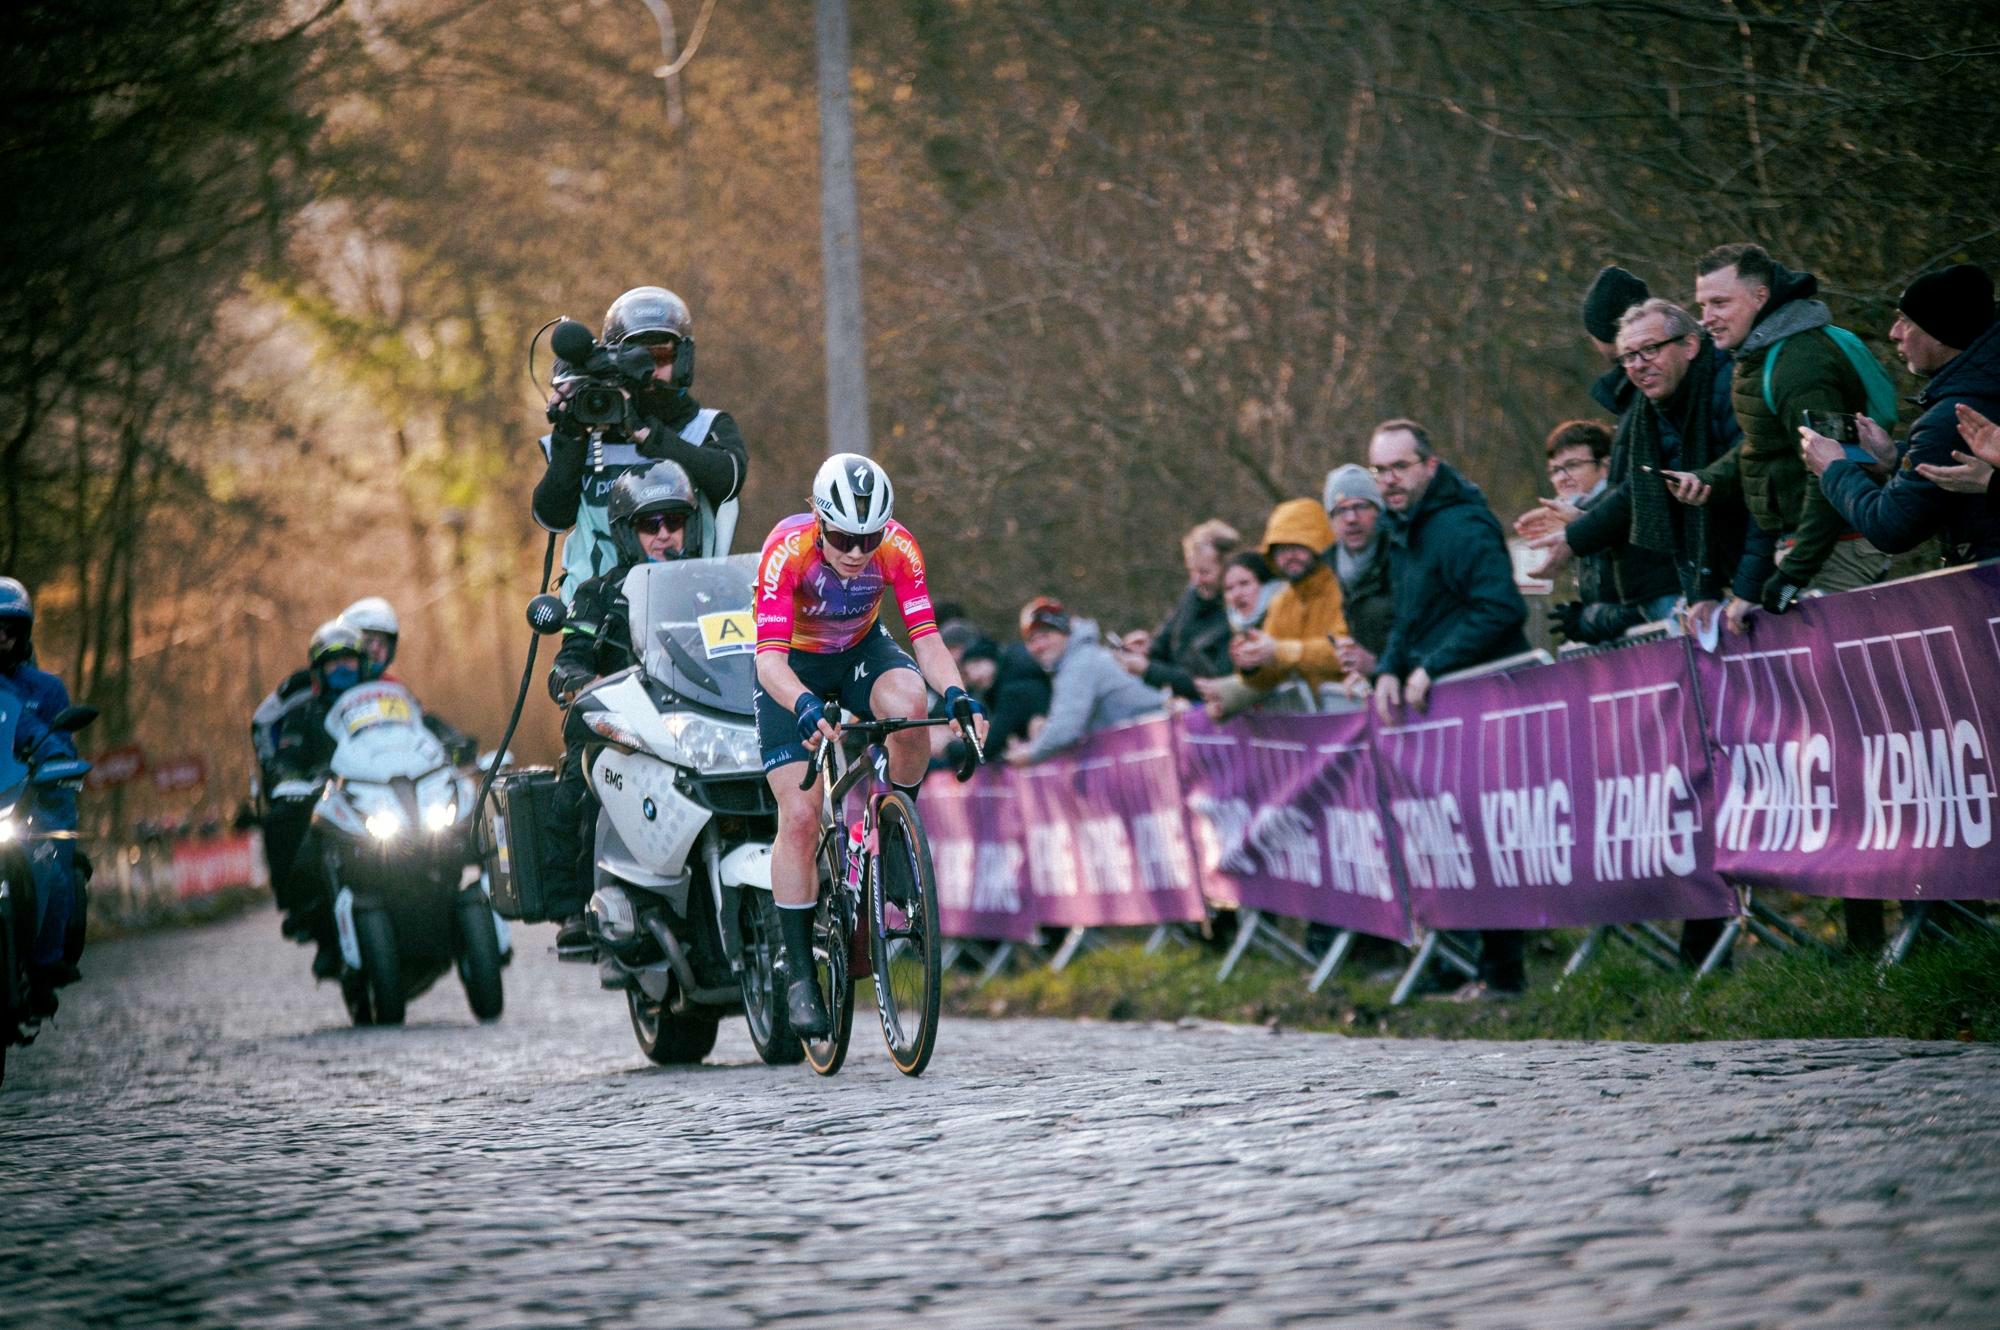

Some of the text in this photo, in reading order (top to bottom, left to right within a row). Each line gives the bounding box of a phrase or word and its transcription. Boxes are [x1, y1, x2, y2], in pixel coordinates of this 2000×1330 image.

[720, 618, 745, 640] A
[605, 767, 623, 792] EMG
[1479, 779, 1573, 887] KPMG
[1594, 763, 1697, 882] KPMG
[1715, 733, 1832, 853] KPMG
[1857, 719, 1992, 849] KPMG
